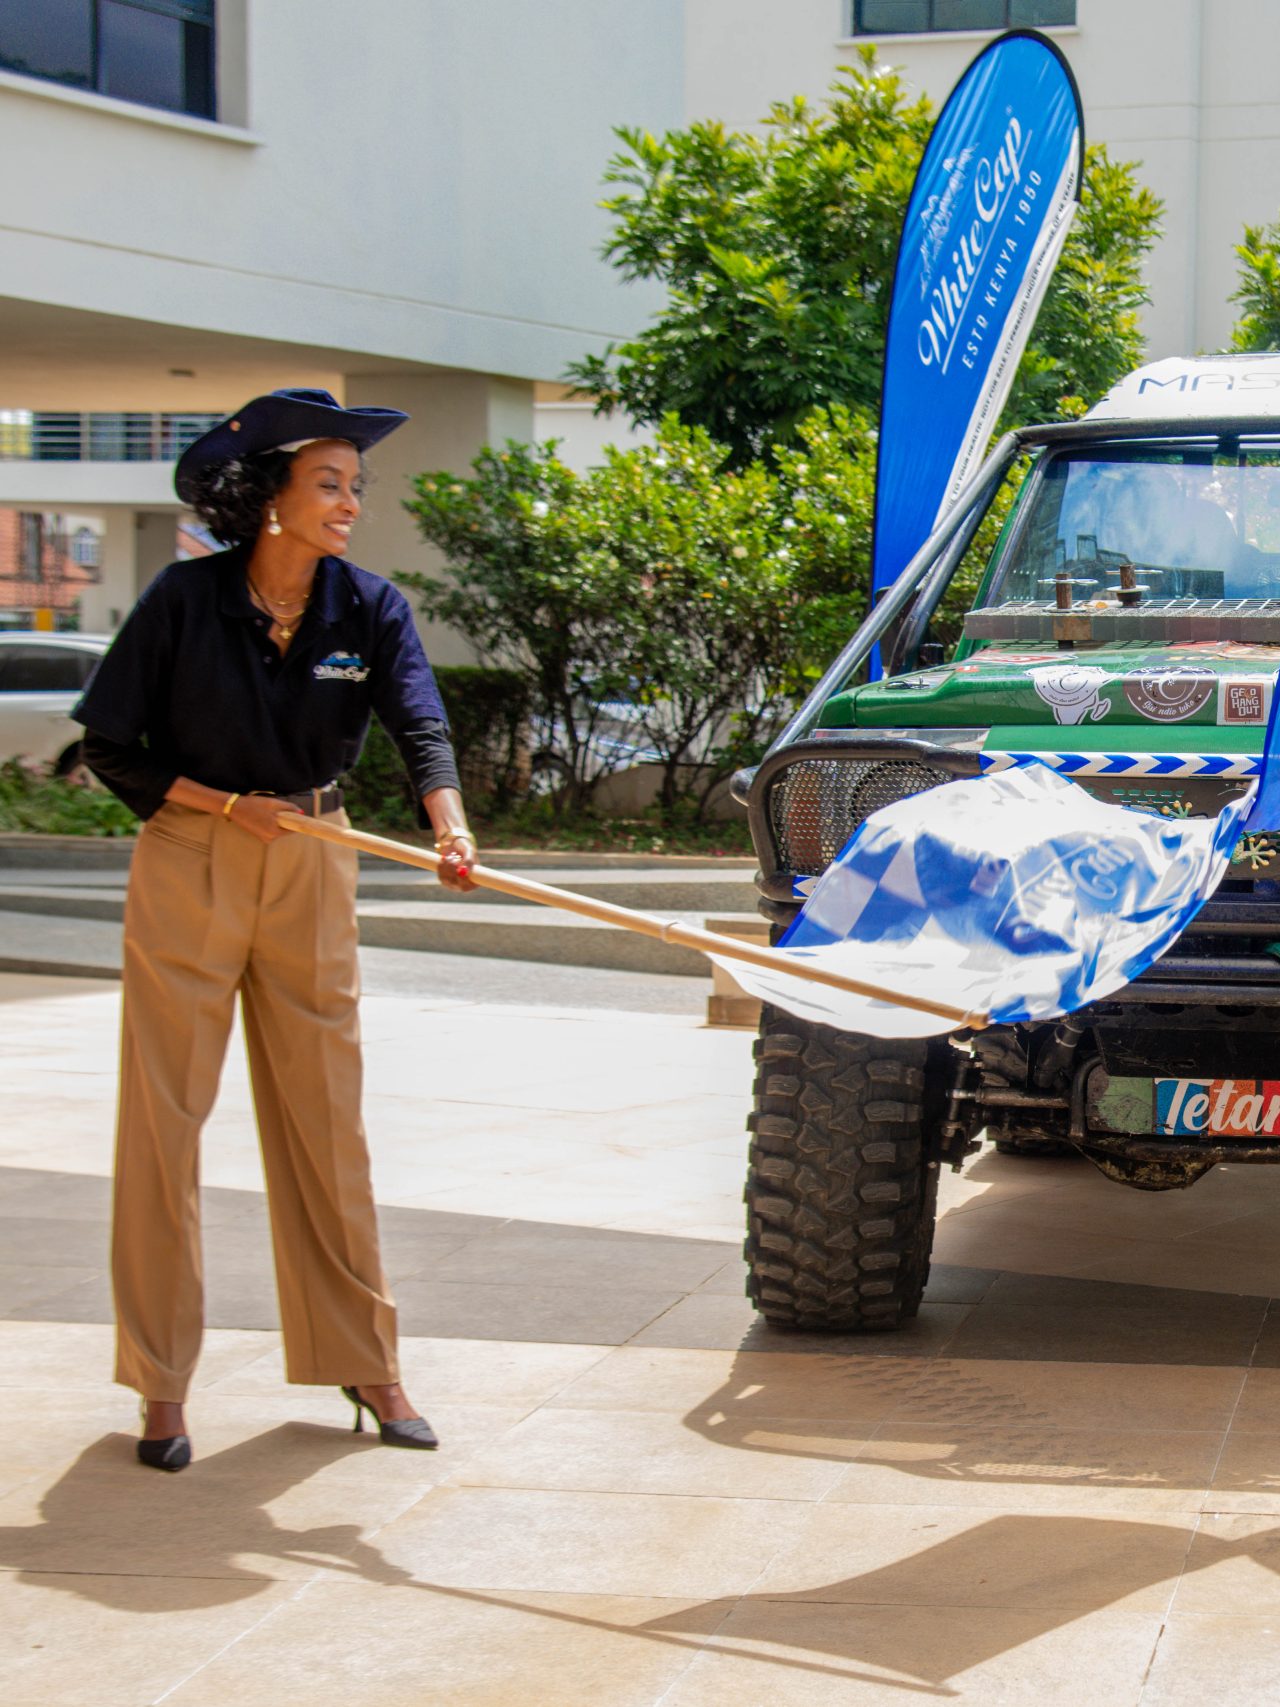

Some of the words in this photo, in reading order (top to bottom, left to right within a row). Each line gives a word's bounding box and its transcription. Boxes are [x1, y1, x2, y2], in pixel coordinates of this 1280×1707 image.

[918, 219, 984, 366] White
[974, 117, 1021, 222] Cap
[962, 314, 989, 370] ESTD
[984, 236, 1018, 307] KENYA
[981, 399, 991, 418] NOT
[988, 379, 998, 398] FOR
[1025, 267, 1040, 298] UNDER
[1231, 696, 1259, 708] HANG
[1238, 705, 1260, 716] OUT
